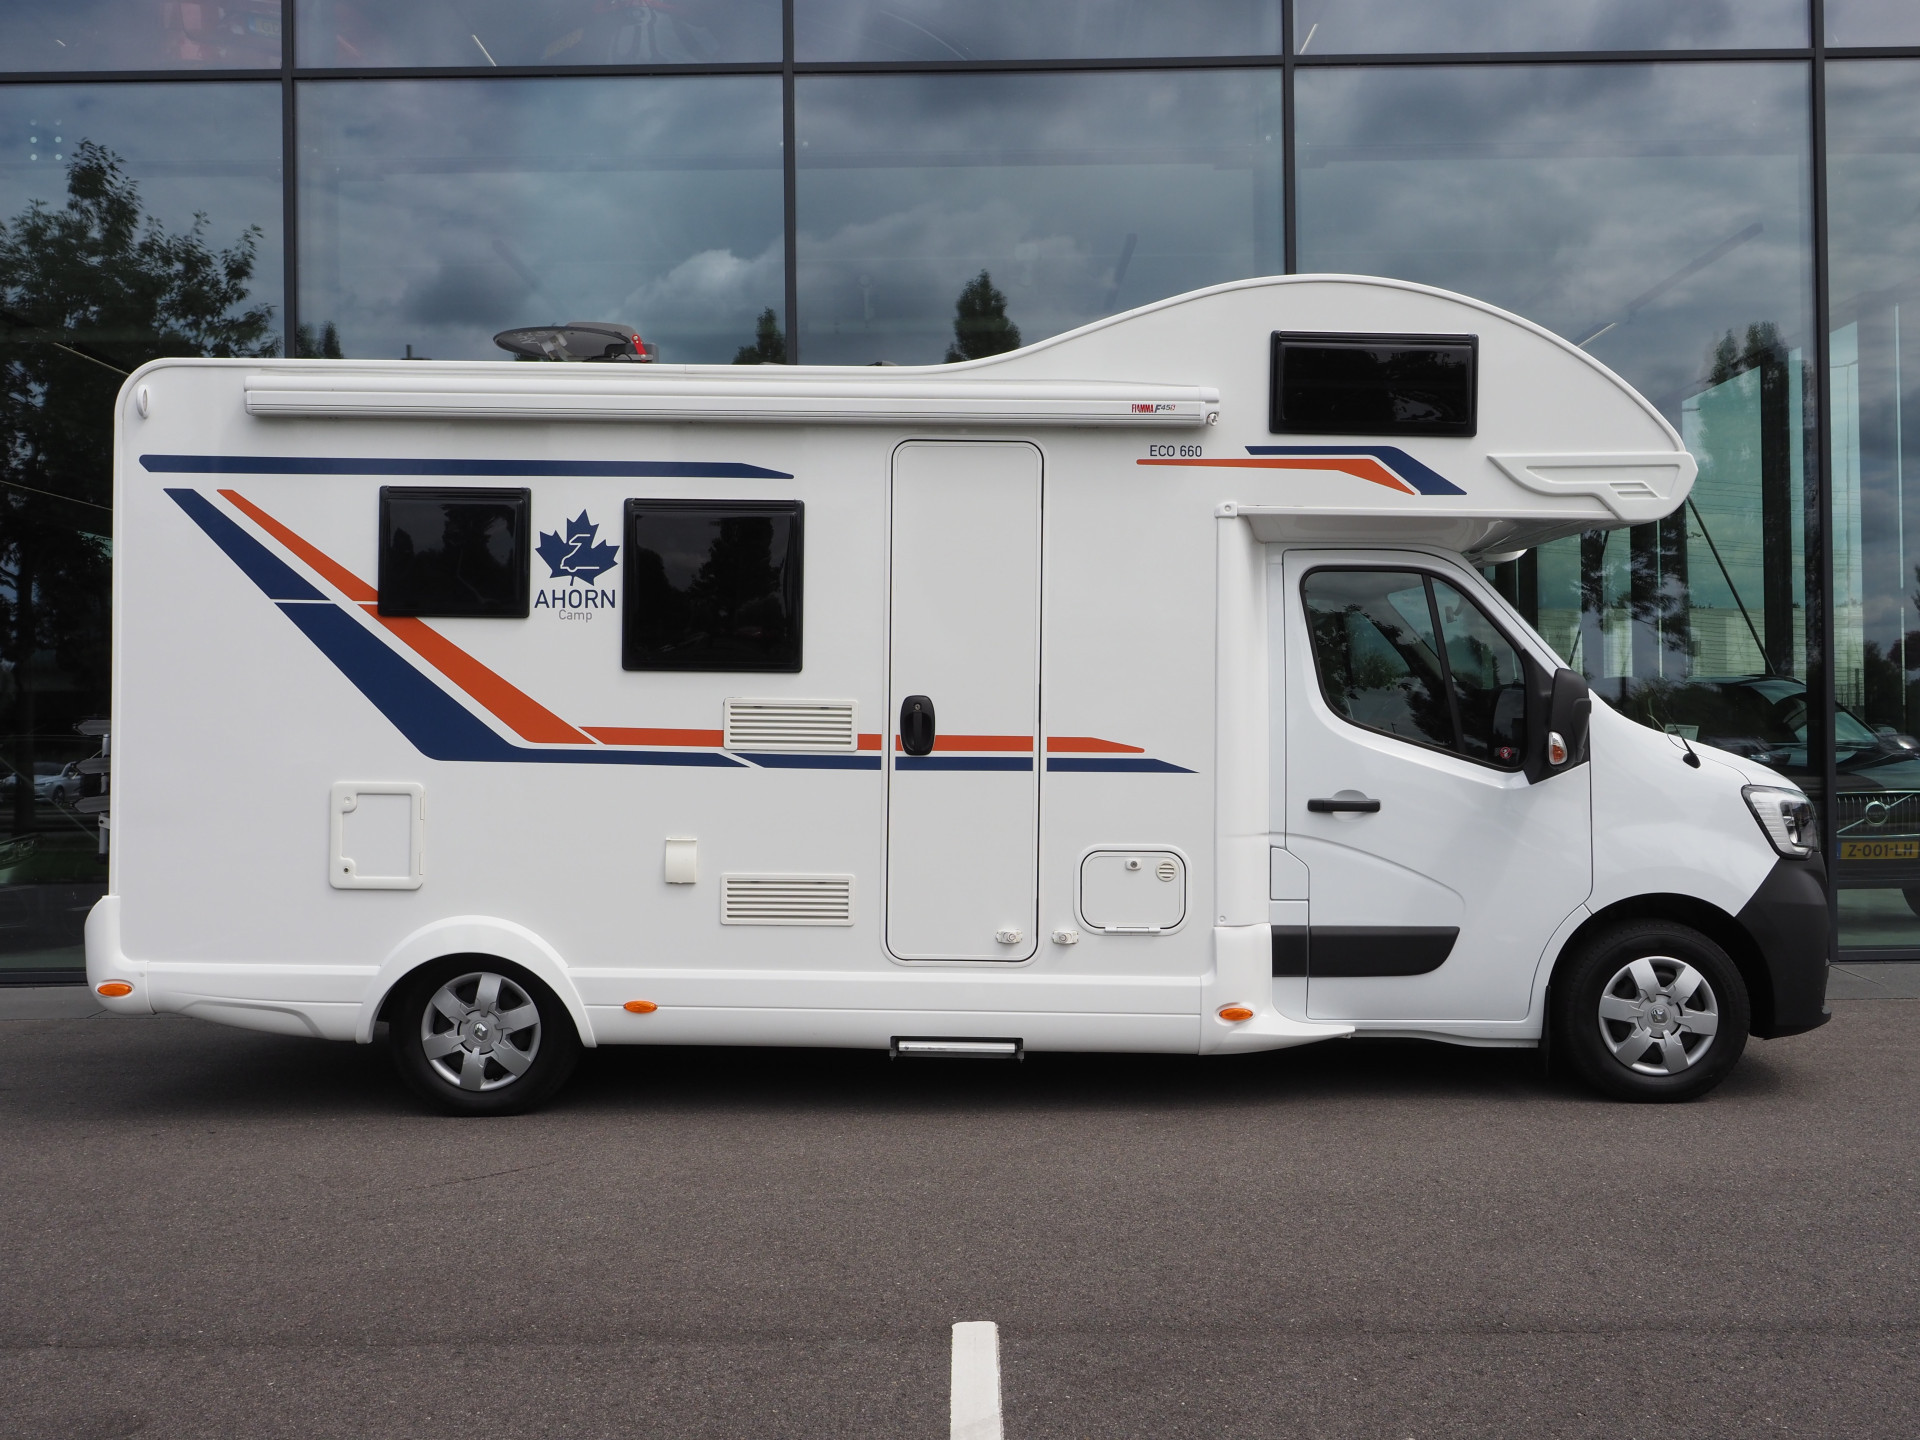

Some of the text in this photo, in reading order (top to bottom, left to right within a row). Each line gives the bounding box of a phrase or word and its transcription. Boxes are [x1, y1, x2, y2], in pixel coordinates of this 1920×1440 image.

[1132, 404, 1154, 413] FIAMMA
[1150, 445, 1202, 457] ECO 660
[534, 589, 616, 608] AHORN
[558, 609, 593, 623] Camp
[1848, 844, 1913, 857] Z-001-LH
